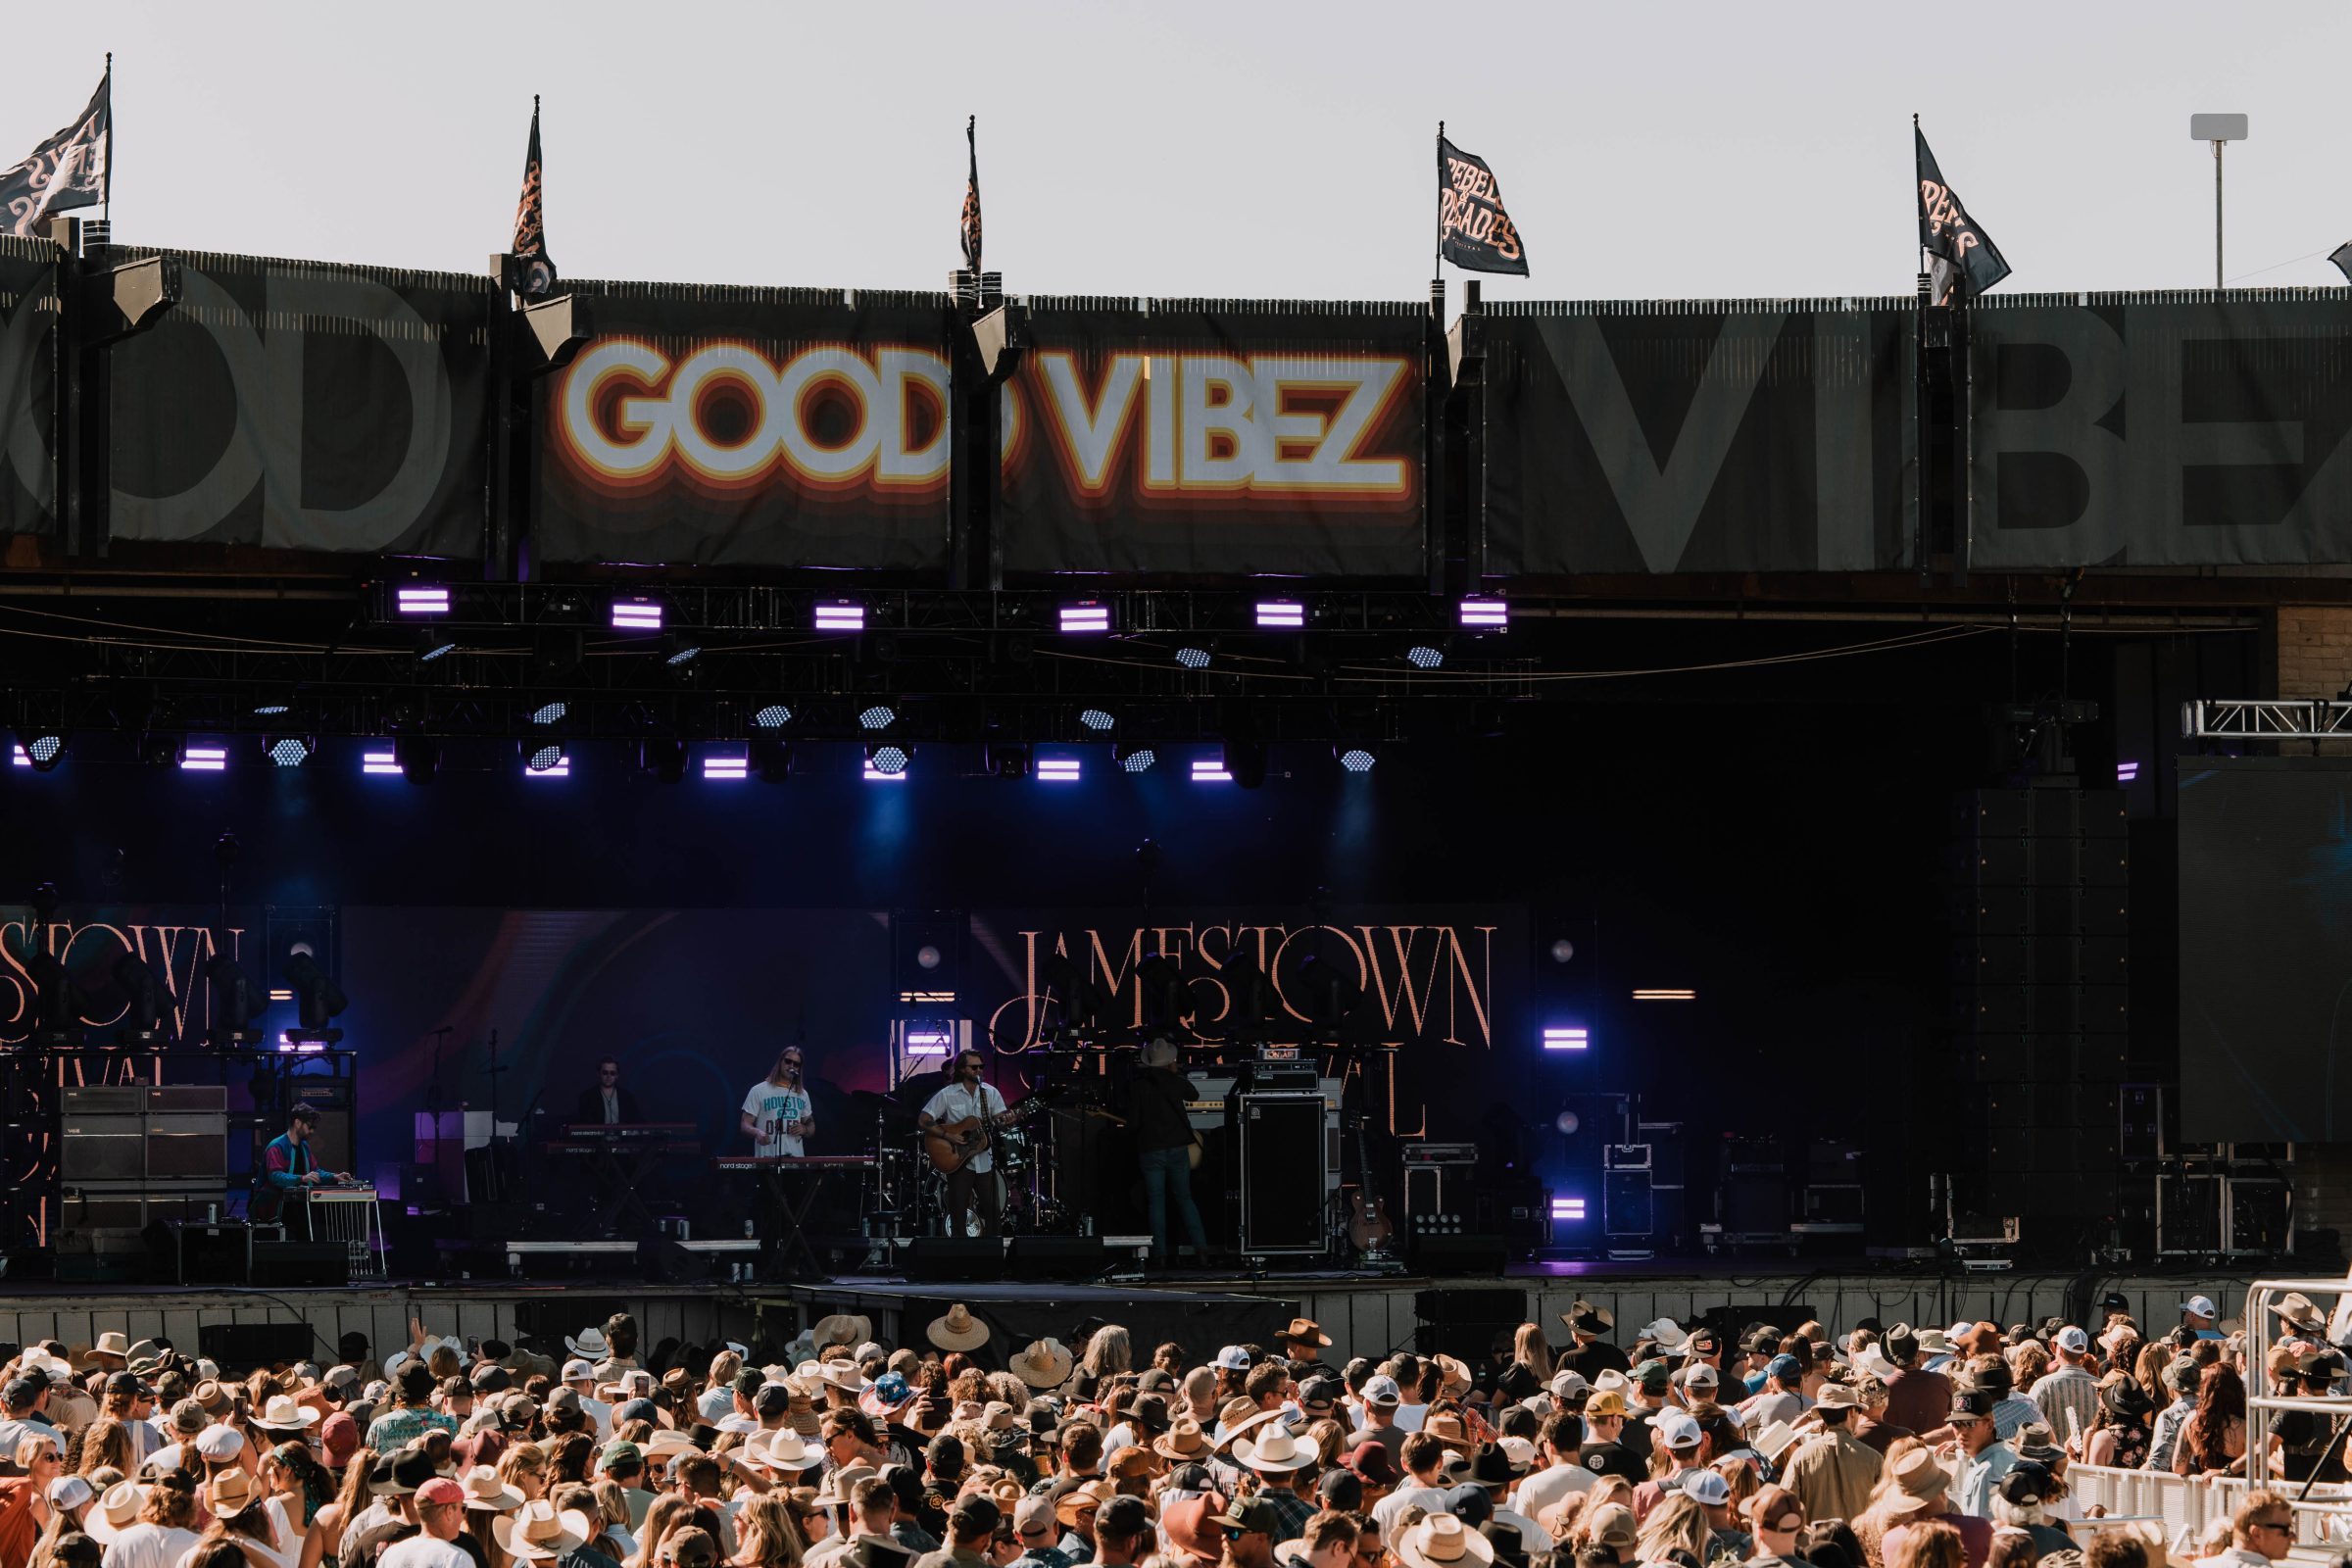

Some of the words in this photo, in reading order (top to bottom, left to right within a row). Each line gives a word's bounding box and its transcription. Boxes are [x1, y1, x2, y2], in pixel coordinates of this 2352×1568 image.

[1442, 187, 1520, 261] READES
[562, 338, 1018, 481] GOOD
[1038, 351, 1411, 492] VIBEZ
[1533, 309, 2352, 574] VIBE
